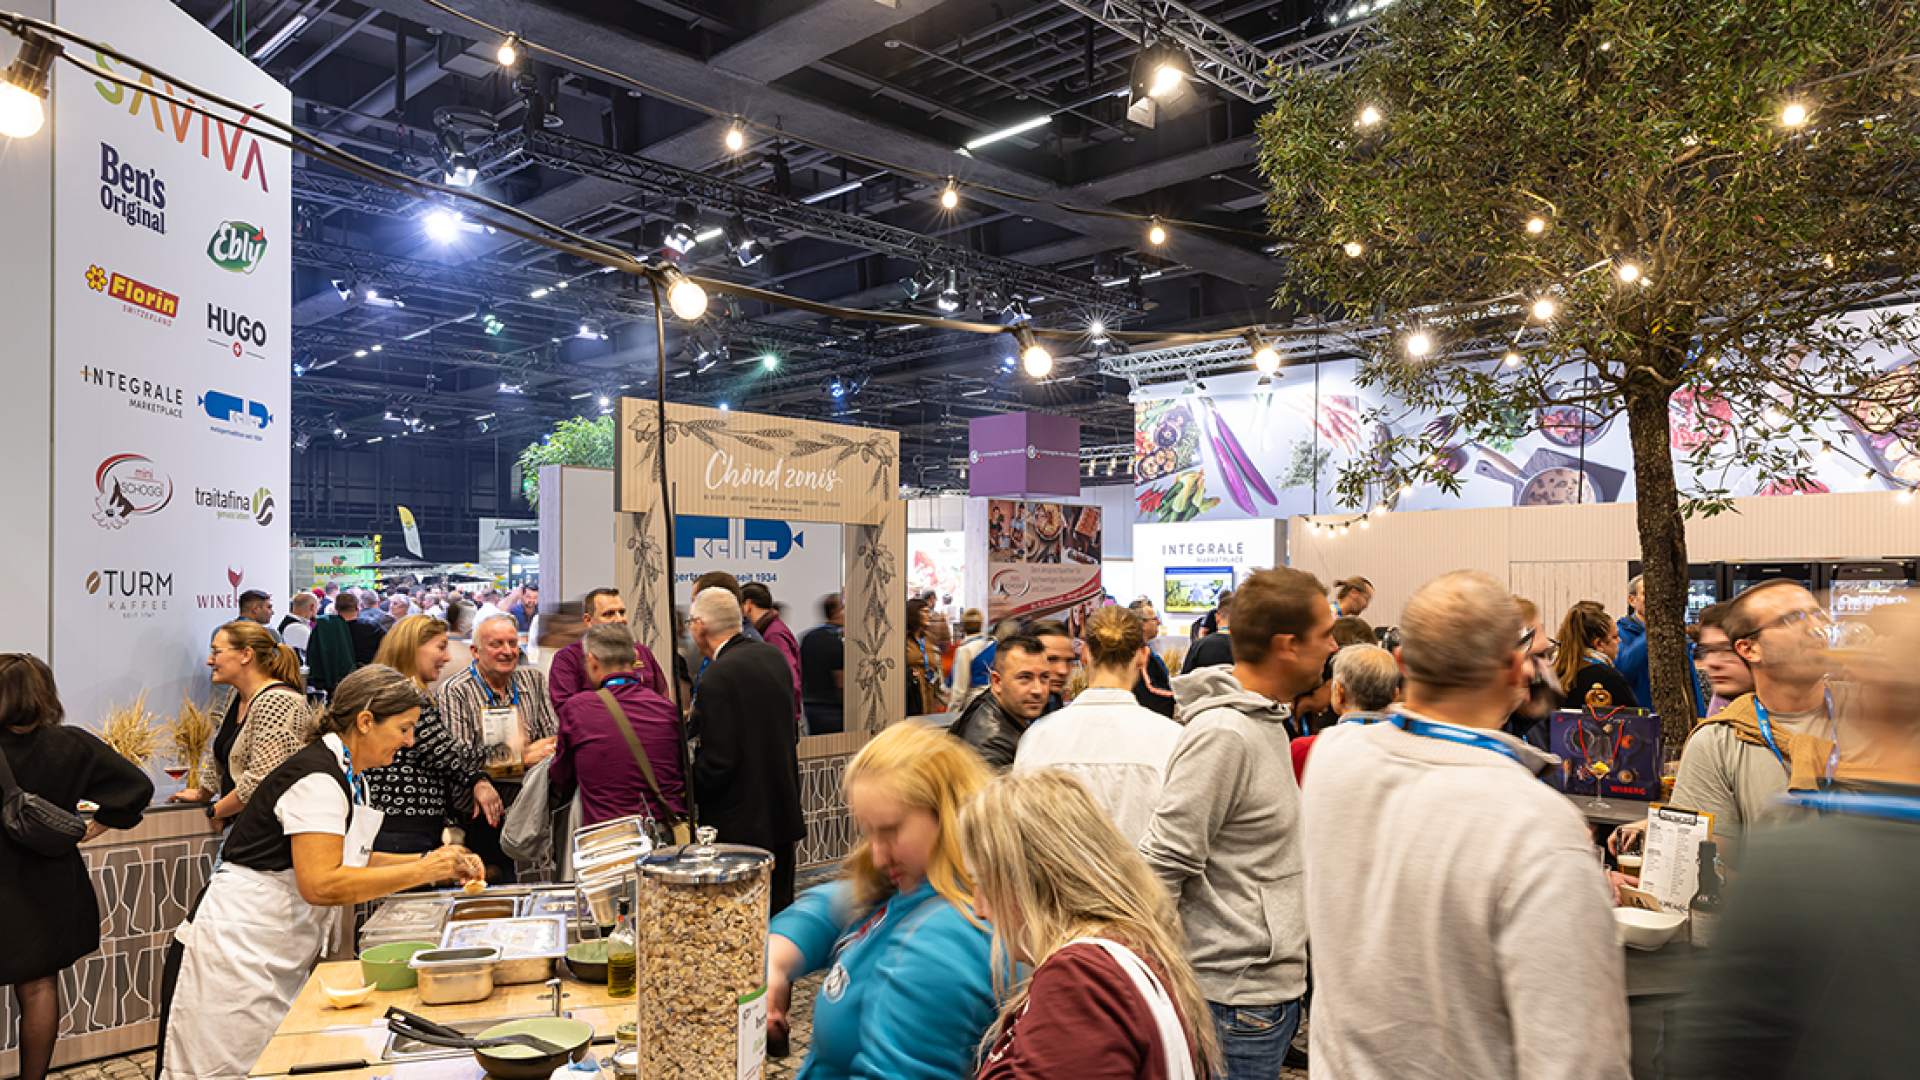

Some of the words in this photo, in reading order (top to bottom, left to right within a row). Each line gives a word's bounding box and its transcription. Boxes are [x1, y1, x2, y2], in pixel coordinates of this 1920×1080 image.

[100, 141, 166, 209] Ben's
[100, 184, 165, 235] Original
[213, 221, 263, 273] Ebly
[112, 275, 175, 315] Florin
[122, 304, 172, 327] SWITZERLAND
[207, 302, 267, 347] HUGO
[83, 364, 184, 406] INTEGRALE
[128, 398, 183, 419] MARKETPLACE
[134, 468, 154, 479] mini
[705, 449, 783, 491] Chönd
[784, 468, 844, 492] zonis
[122, 482, 164, 498] SCHOGGI
[195, 487, 250, 511] traitafina
[1162, 542, 1244, 555] INTEGRALE
[1196, 556, 1244, 564] MARKETPLACE
[104, 570, 173, 597] TURM
[755, 572, 778, 582] 1934
[108, 600, 168, 611] KAFFEE
[1609, 785, 1646, 795] WIBERG
